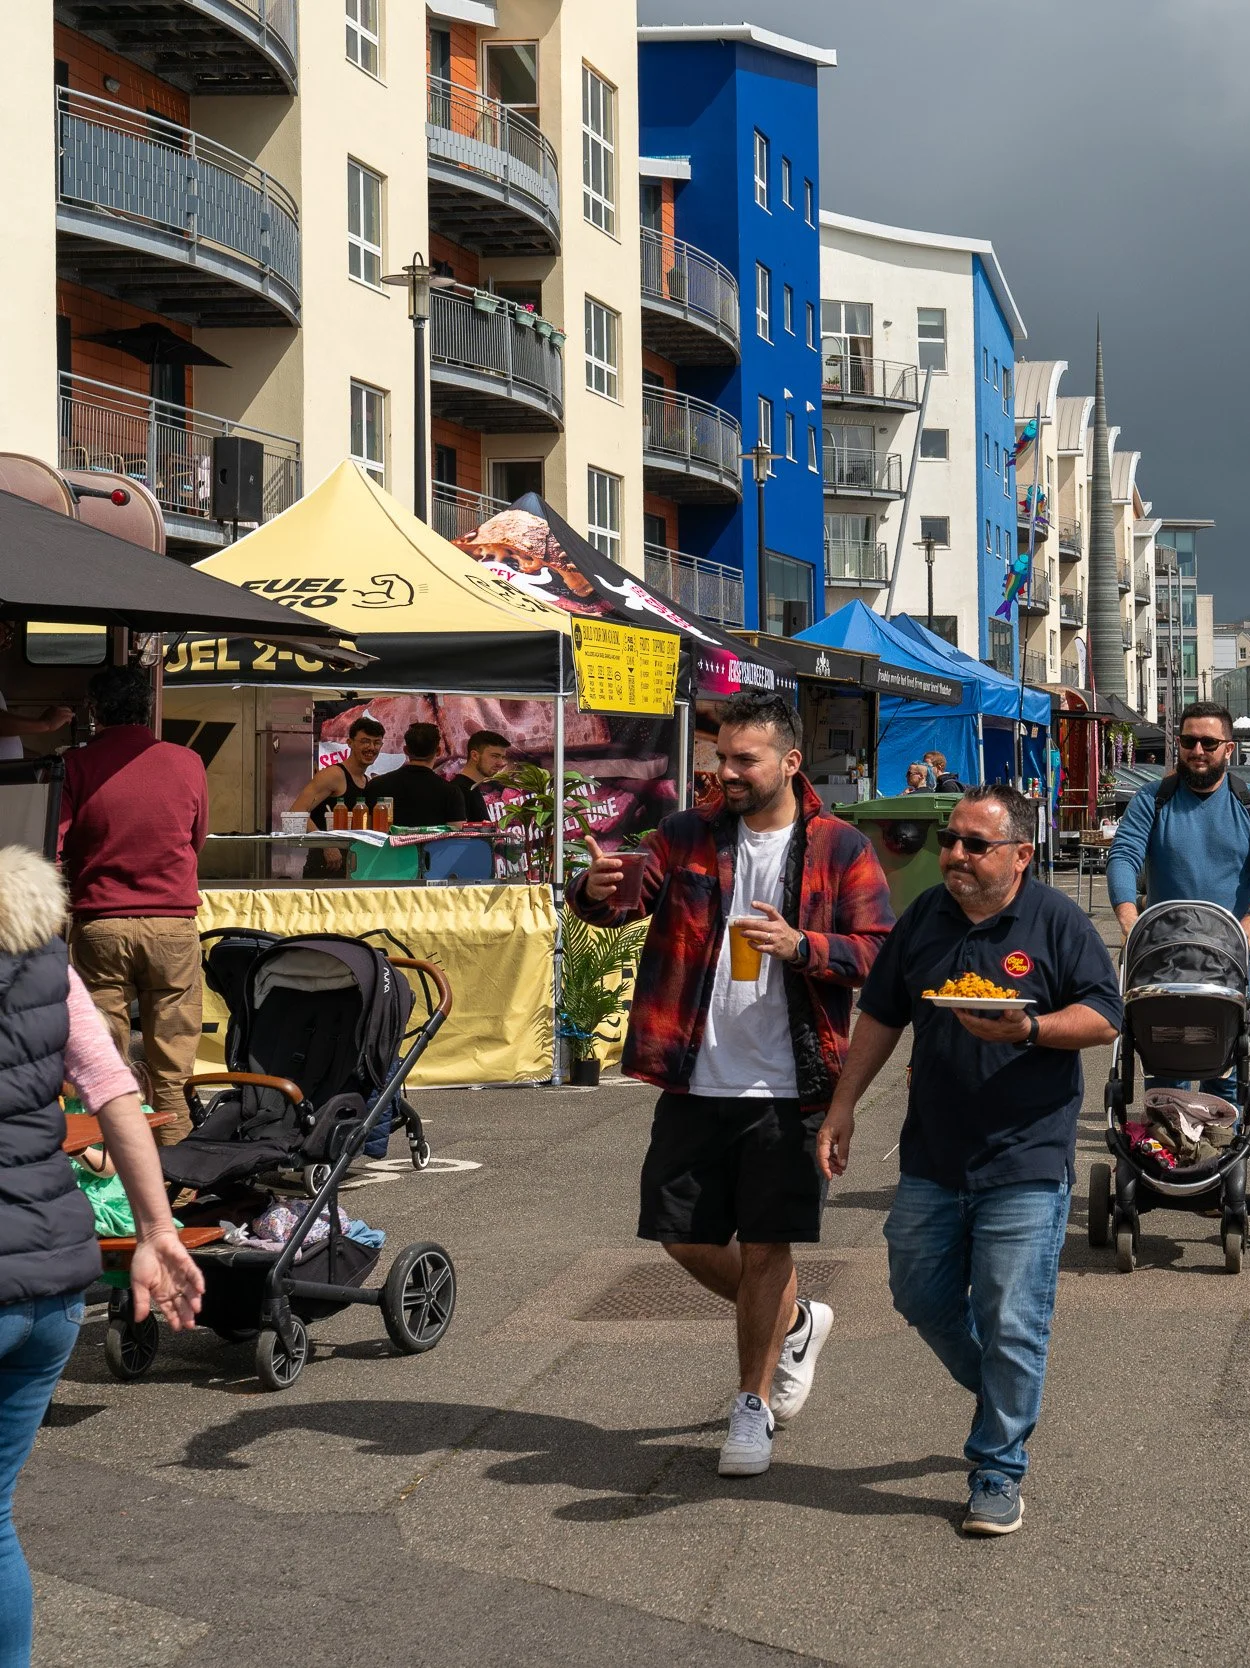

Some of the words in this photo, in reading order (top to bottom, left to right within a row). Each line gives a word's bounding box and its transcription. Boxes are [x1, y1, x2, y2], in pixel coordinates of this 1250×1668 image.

[240, 578, 348, 593] FUEL
[277, 594, 339, 608] GO
[163, 637, 241, 673] UEL
[728, 659, 775, 691] JERSEYSALTBEEF.COM
[877, 668, 891, 686] freshly
[891, 674, 901, 685] made
[383, 966, 391, 994] nuna
